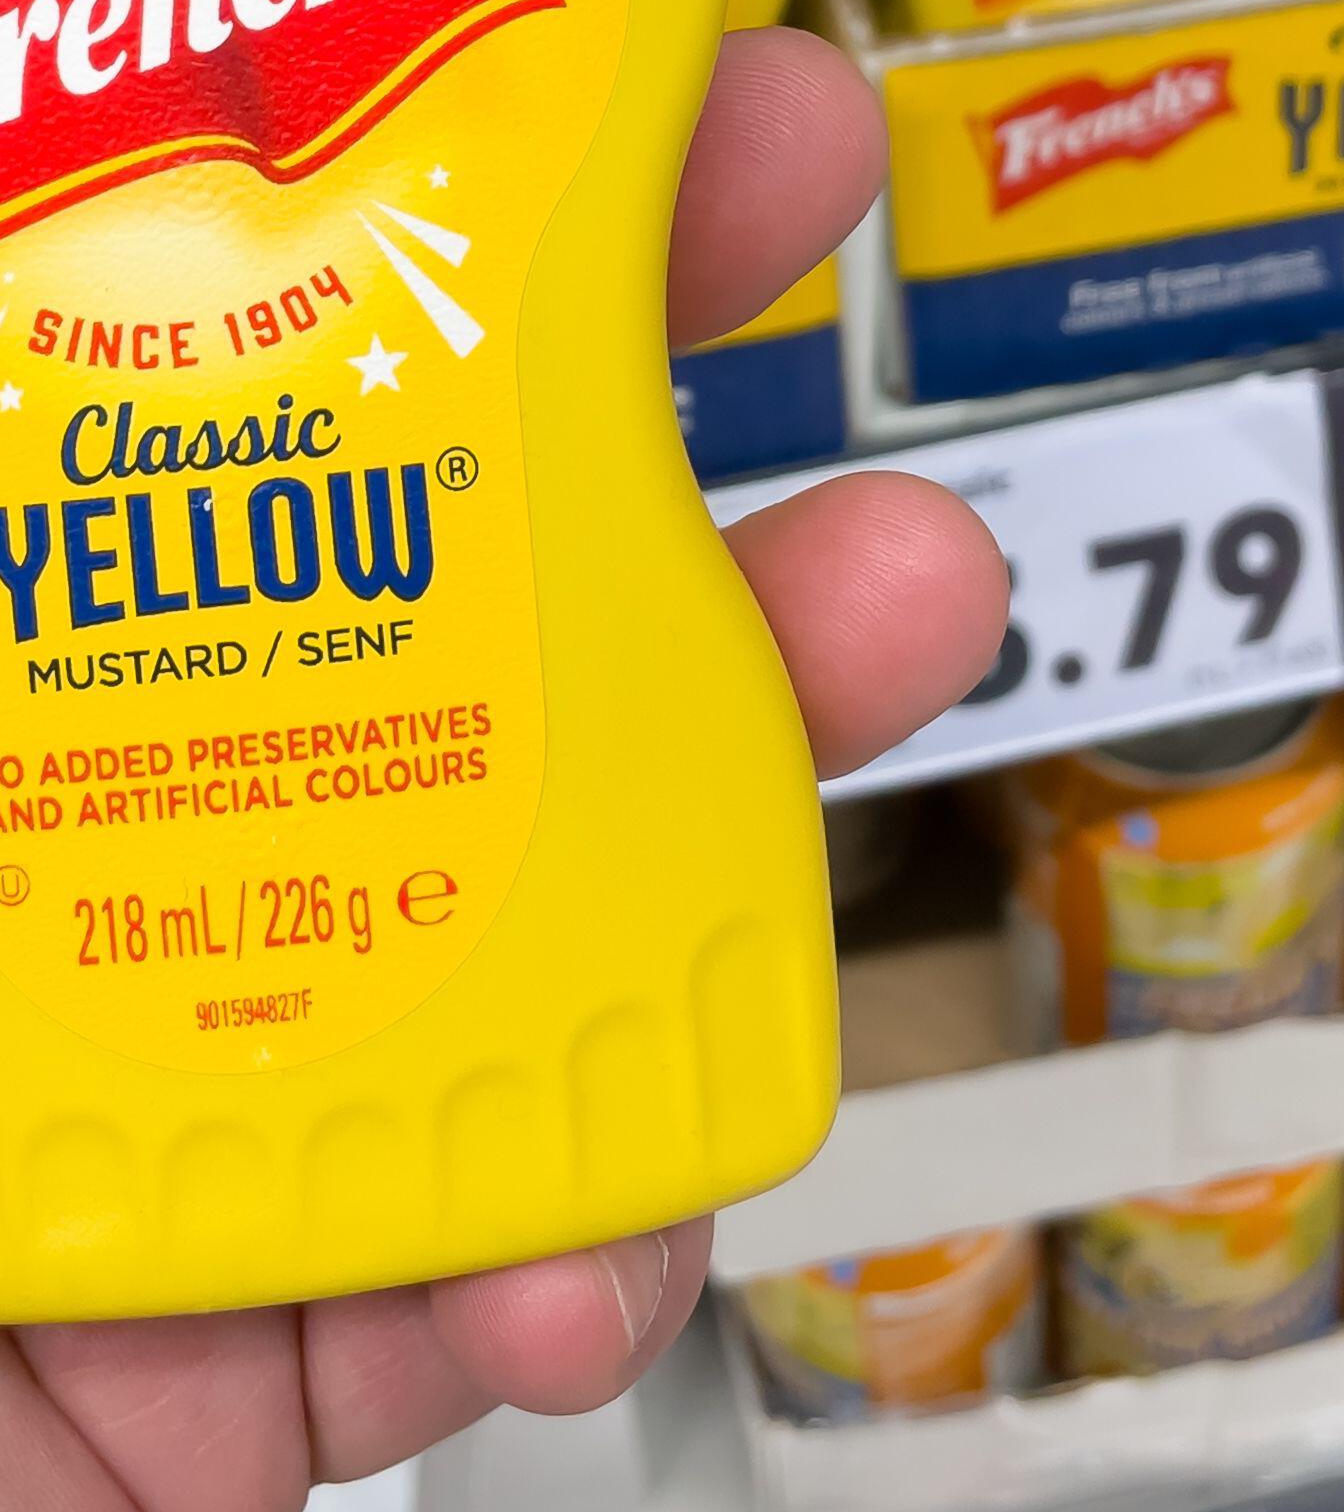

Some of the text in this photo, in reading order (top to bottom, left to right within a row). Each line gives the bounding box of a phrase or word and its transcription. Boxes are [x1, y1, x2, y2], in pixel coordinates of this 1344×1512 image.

[27, 263, 354, 372] SINCE 1904
[60, 392, 342, 487] Classic
[27, 640, 248, 694] MUSTARD
[297, 619, 416, 668] SENF
[39, 741, 174, 786] ADDED
[187, 702, 492, 772] PRESERVATIVES
[76, 774, 293, 828] ARTIFICIAL
[305, 747, 489, 804] COLOURS
[74, 894, 149, 967] 218
[259, 874, 334, 948] 226
[196, 988, 314, 1031] 901594827F
